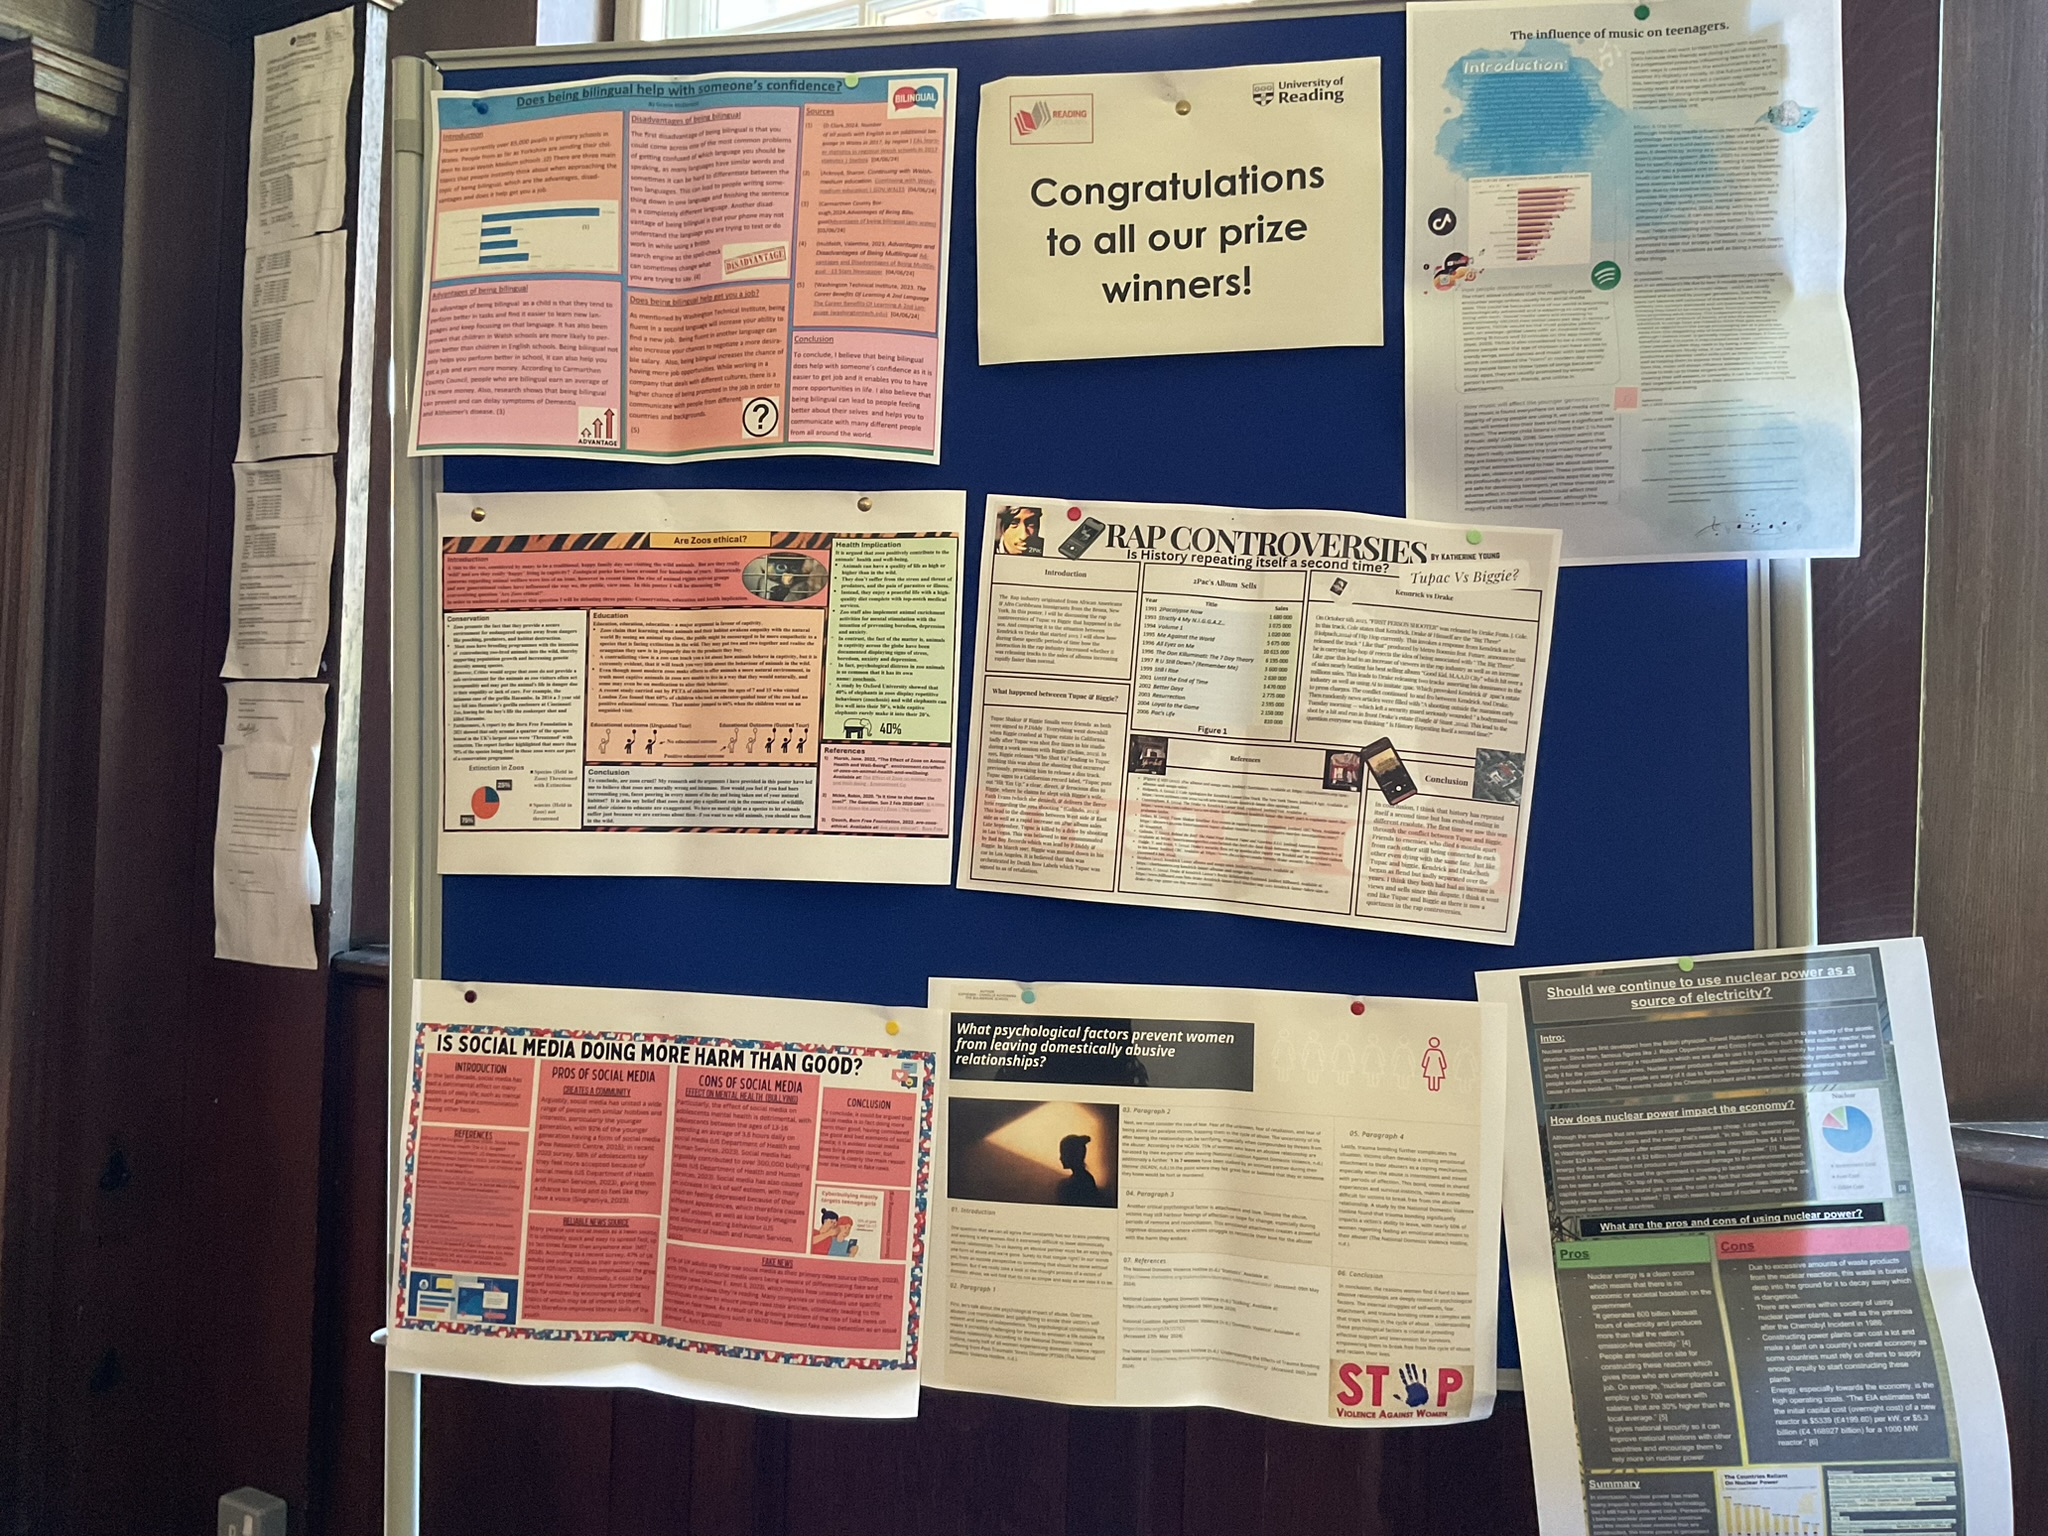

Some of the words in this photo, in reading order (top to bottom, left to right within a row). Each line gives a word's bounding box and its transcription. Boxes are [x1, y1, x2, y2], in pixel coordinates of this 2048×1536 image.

[1510, 31, 1533, 40] The
[1536, 30, 1591, 39] influence
[1594, 29, 1606, 39] of
[1609, 29, 1644, 38] music
[1647, 28, 1663, 38] on
[1666, 22, 1729, 36] teenagers.
[1278, 78, 1331, 90] University
[1333, 77, 1344, 86] of
[517, 96, 544, 107] Does
[548, 92, 578, 103] being
[582, 84, 633, 98] bilingual
[637, 84, 664, 96] help
[668, 84, 695, 96] with
[698, 80, 763, 95] someone's
[767, 79, 842, 91] confidence?
[895, 93, 936, 103] BILINGUAL
[1278, 88, 1344, 104] Reading
[631, 115, 684, 124] Disadvantages
[685, 115, 693, 123] of
[694, 113, 710, 123] being
[711, 111, 741, 121] bilingual
[1052, 109, 1087, 119] READING
[1030, 164, 1324, 211] Congratulations
[1047, 227, 1081, 257] to
[1093, 224, 1135, 255] all
[1148, 226, 1206, 252] our
[1219, 215, 1307, 254] prize
[726, 250, 784, 271] DISADVANTAGE
[1102, 265, 1252, 304] winners!
[674, 536, 689, 544] Are
[691, 536, 710, 544] Zoos
[712, 535, 748, 544] ethical?
[1105, 524, 1166, 549] RAP
[1170, 526, 1428, 564] CONTROVERSIES
[1127, 550, 1137, 559] Is
[1141, 550, 1188, 565] History
[1191, 552, 1252, 570] repeating
[1255, 556, 1288, 568] itself
[1301, 559, 1349, 570] second
[1353, 562, 1390, 573] time?
[1045, 569, 1086, 578] Introduction
[1411, 572, 1450, 585] Tupac
[1455, 572, 1469, 583] Vs
[1473, 569, 1519, 583] Biggie?
[1216, 580, 1238, 588] Album
[1009, 689, 1038, 697] happened
[1068, 692, 1086, 700] Tupac
[1096, 694, 1118, 702] Biggie?
[880, 722, 902, 735] 40%
[1198, 726, 1221, 734] Figure
[1230, 755, 1261, 763] References
[1425, 775, 1468, 786] Conclusion
[1547, 986, 1593, 999] Should
[1597, 985, 1616, 994] we
[1620, 979, 1677, 993] continue
[1680, 977, 1693, 988] to
[1697, 977, 1721, 987] use
[1725, 972, 1777, 984] nuclear
[1781, 970, 1823, 982] power
[1828, 966, 1843, 976] as
[1847, 966, 1855, 975] a
[1631, 996, 1675, 1008] source
[1679, 994, 1692, 1005] of
[1696, 987, 1772, 1003] electricity?
[956, 1023, 990, 1036] What
[993, 1024, 1080, 1041] psychological
[1082, 1027, 1129, 1041] factors
[1132, 1030, 1183, 1043] prevent
[1186, 1032, 1234, 1043] women
[1540, 1034, 1566, 1044] Intro:
[955, 1038, 988, 1052] from
[990, 1038, 1037, 1054] leaving
[1040, 1042, 1122, 1058] domestically
[1125, 1044, 1176, 1057] abusive
[437, 1035, 453, 1052] IS
[459, 1035, 517, 1055] SOCIAL
[522, 1038, 575, 1059] MEDIA
[581, 1041, 635, 1061] DOING
[641, 1043, 690, 1064] MORE
[695, 1047, 744, 1068] HARM
[750, 1052, 796, 1071] THAN
[801, 1055, 863, 1076] GOOD?
[956, 1054, 1046, 1070] relationships?
[455, 1062, 507, 1074] INTRODUCTION
[552, 1067, 576, 1079] PROS
[579, 1068, 590, 1080] OF
[592, 1068, 623, 1081] SOCIAL
[627, 1070, 655, 1082] MEDIA
[699, 1075, 723, 1087] CONS
[726, 1076, 737, 1088] OF
[740, 1077, 771, 1090] SOCIAL
[775, 1081, 802, 1093] MEDIA
[847, 1098, 891, 1109] CONCLUSION
[1551, 1116, 1570, 1125] How
[1573, 1114, 1602, 1123] does
[1605, 1111, 1643, 1121] nuclear
[1647, 1109, 1679, 1121] power
[1682, 1105, 1717, 1118] impact
[1720, 1104, 1737, 1114] the
[1740, 1101, 1796, 1114] economy?
[1362, 1131, 1398, 1140] Paragraph
[1600, 1222, 1624, 1231] What
[1646, 1221, 1663, 1229] the
[1666, 1220, 1689, 1230] pros
[1691, 1218, 1710, 1227] and
[1713, 1217, 1737, 1226] cons
[1740, 1216, 1750, 1224] of
[1753, 1215, 1780, 1225] using
[1784, 1211, 1820, 1222] nuclear
[1824, 1209, 1863, 1222] power?
[1721, 1241, 1754, 1252] Cons
[1560, 1249, 1589, 1259] Pros
[762, 1257, 777, 1266] FAKE
[778, 1259, 793, 1268] NEWS
[1337, 1408, 1376, 1417] VIOLENCE
[1379, 1410, 1413, 1418] AGAINST
[1589, 1479, 1640, 1489] Summary
